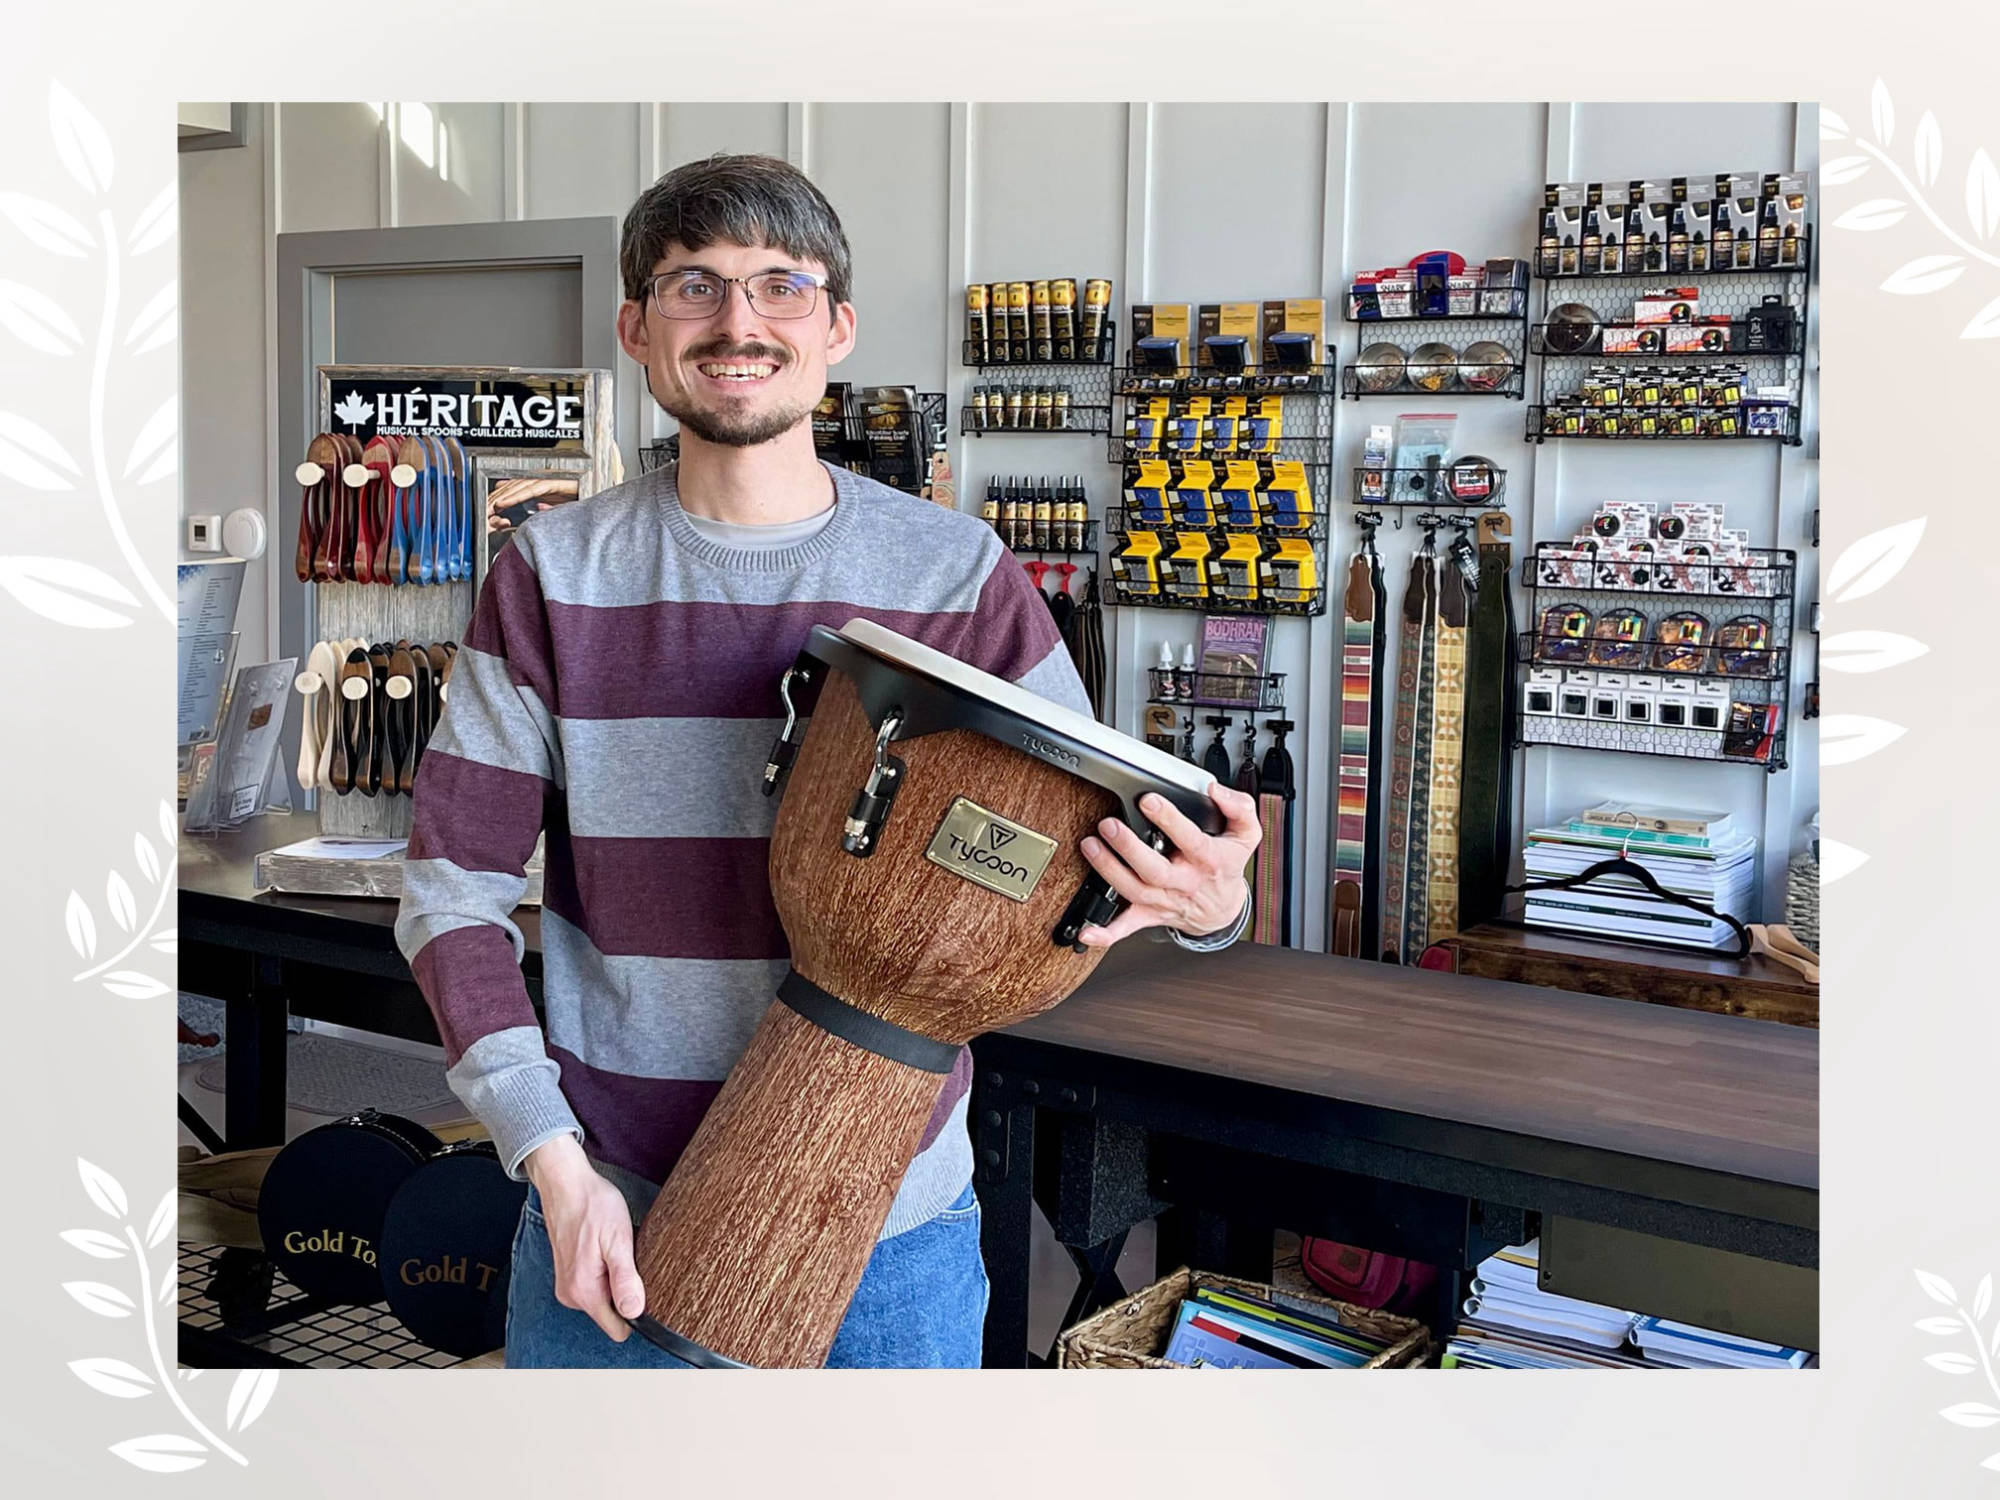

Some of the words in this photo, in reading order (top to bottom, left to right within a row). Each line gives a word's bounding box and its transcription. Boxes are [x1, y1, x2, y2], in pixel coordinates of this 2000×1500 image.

[376, 387, 581, 429] HÉRITAGE
[376, 425, 419, 436] MUSICAL
[421, 426, 463, 437] SPOONS
[470, 427, 523, 438] CUILLÈRES
[525, 428, 580, 439] MUSICALES
[284, 1229, 344, 1254] Gold
[350, 1235, 377, 1268] To
[400, 1255, 468, 1286] Gold
